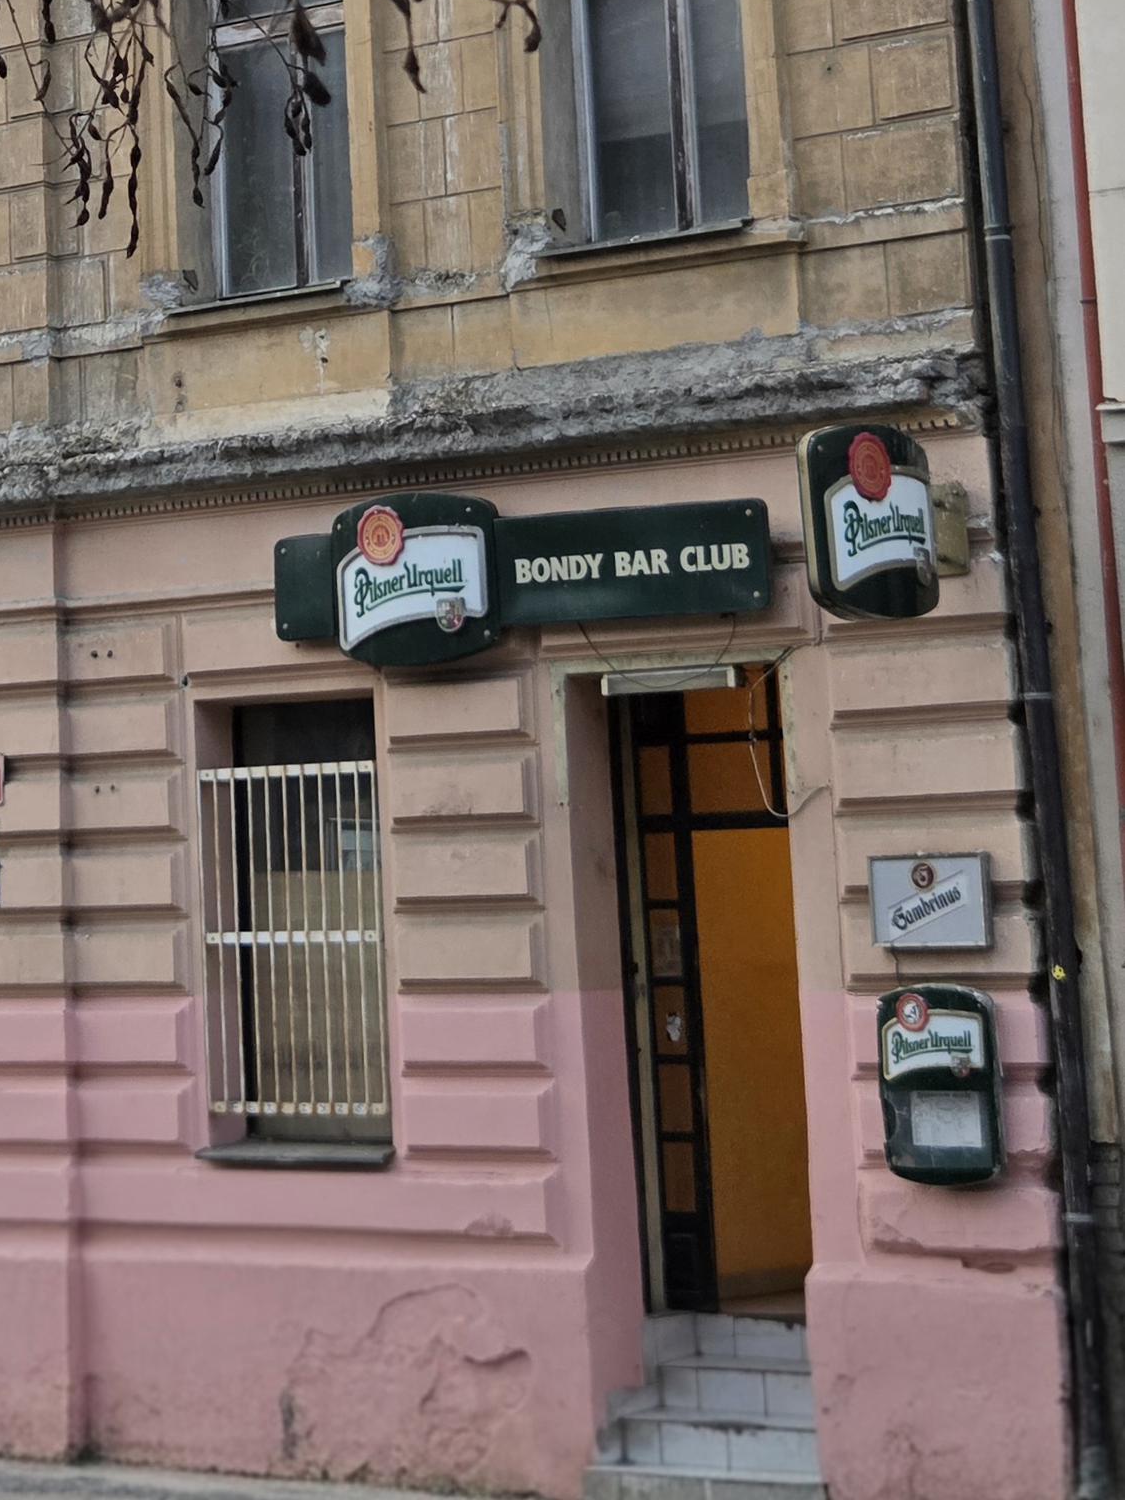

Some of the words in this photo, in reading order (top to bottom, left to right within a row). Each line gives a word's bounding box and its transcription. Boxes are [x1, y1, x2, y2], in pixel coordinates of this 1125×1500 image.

[844, 500, 893, 557] Pilsner
[514, 553, 603, 584] BONDY
[614, 549, 670, 576] BAR
[680, 543, 750, 572] CLUB
[354, 566, 405, 618] Pilsner
[404, 558, 463, 596] Urquell
[891, 885, 962, 931] Gambrinus
[891, 1031, 929, 1064] Pilsner
[928, 1029, 972, 1055] Urquell
